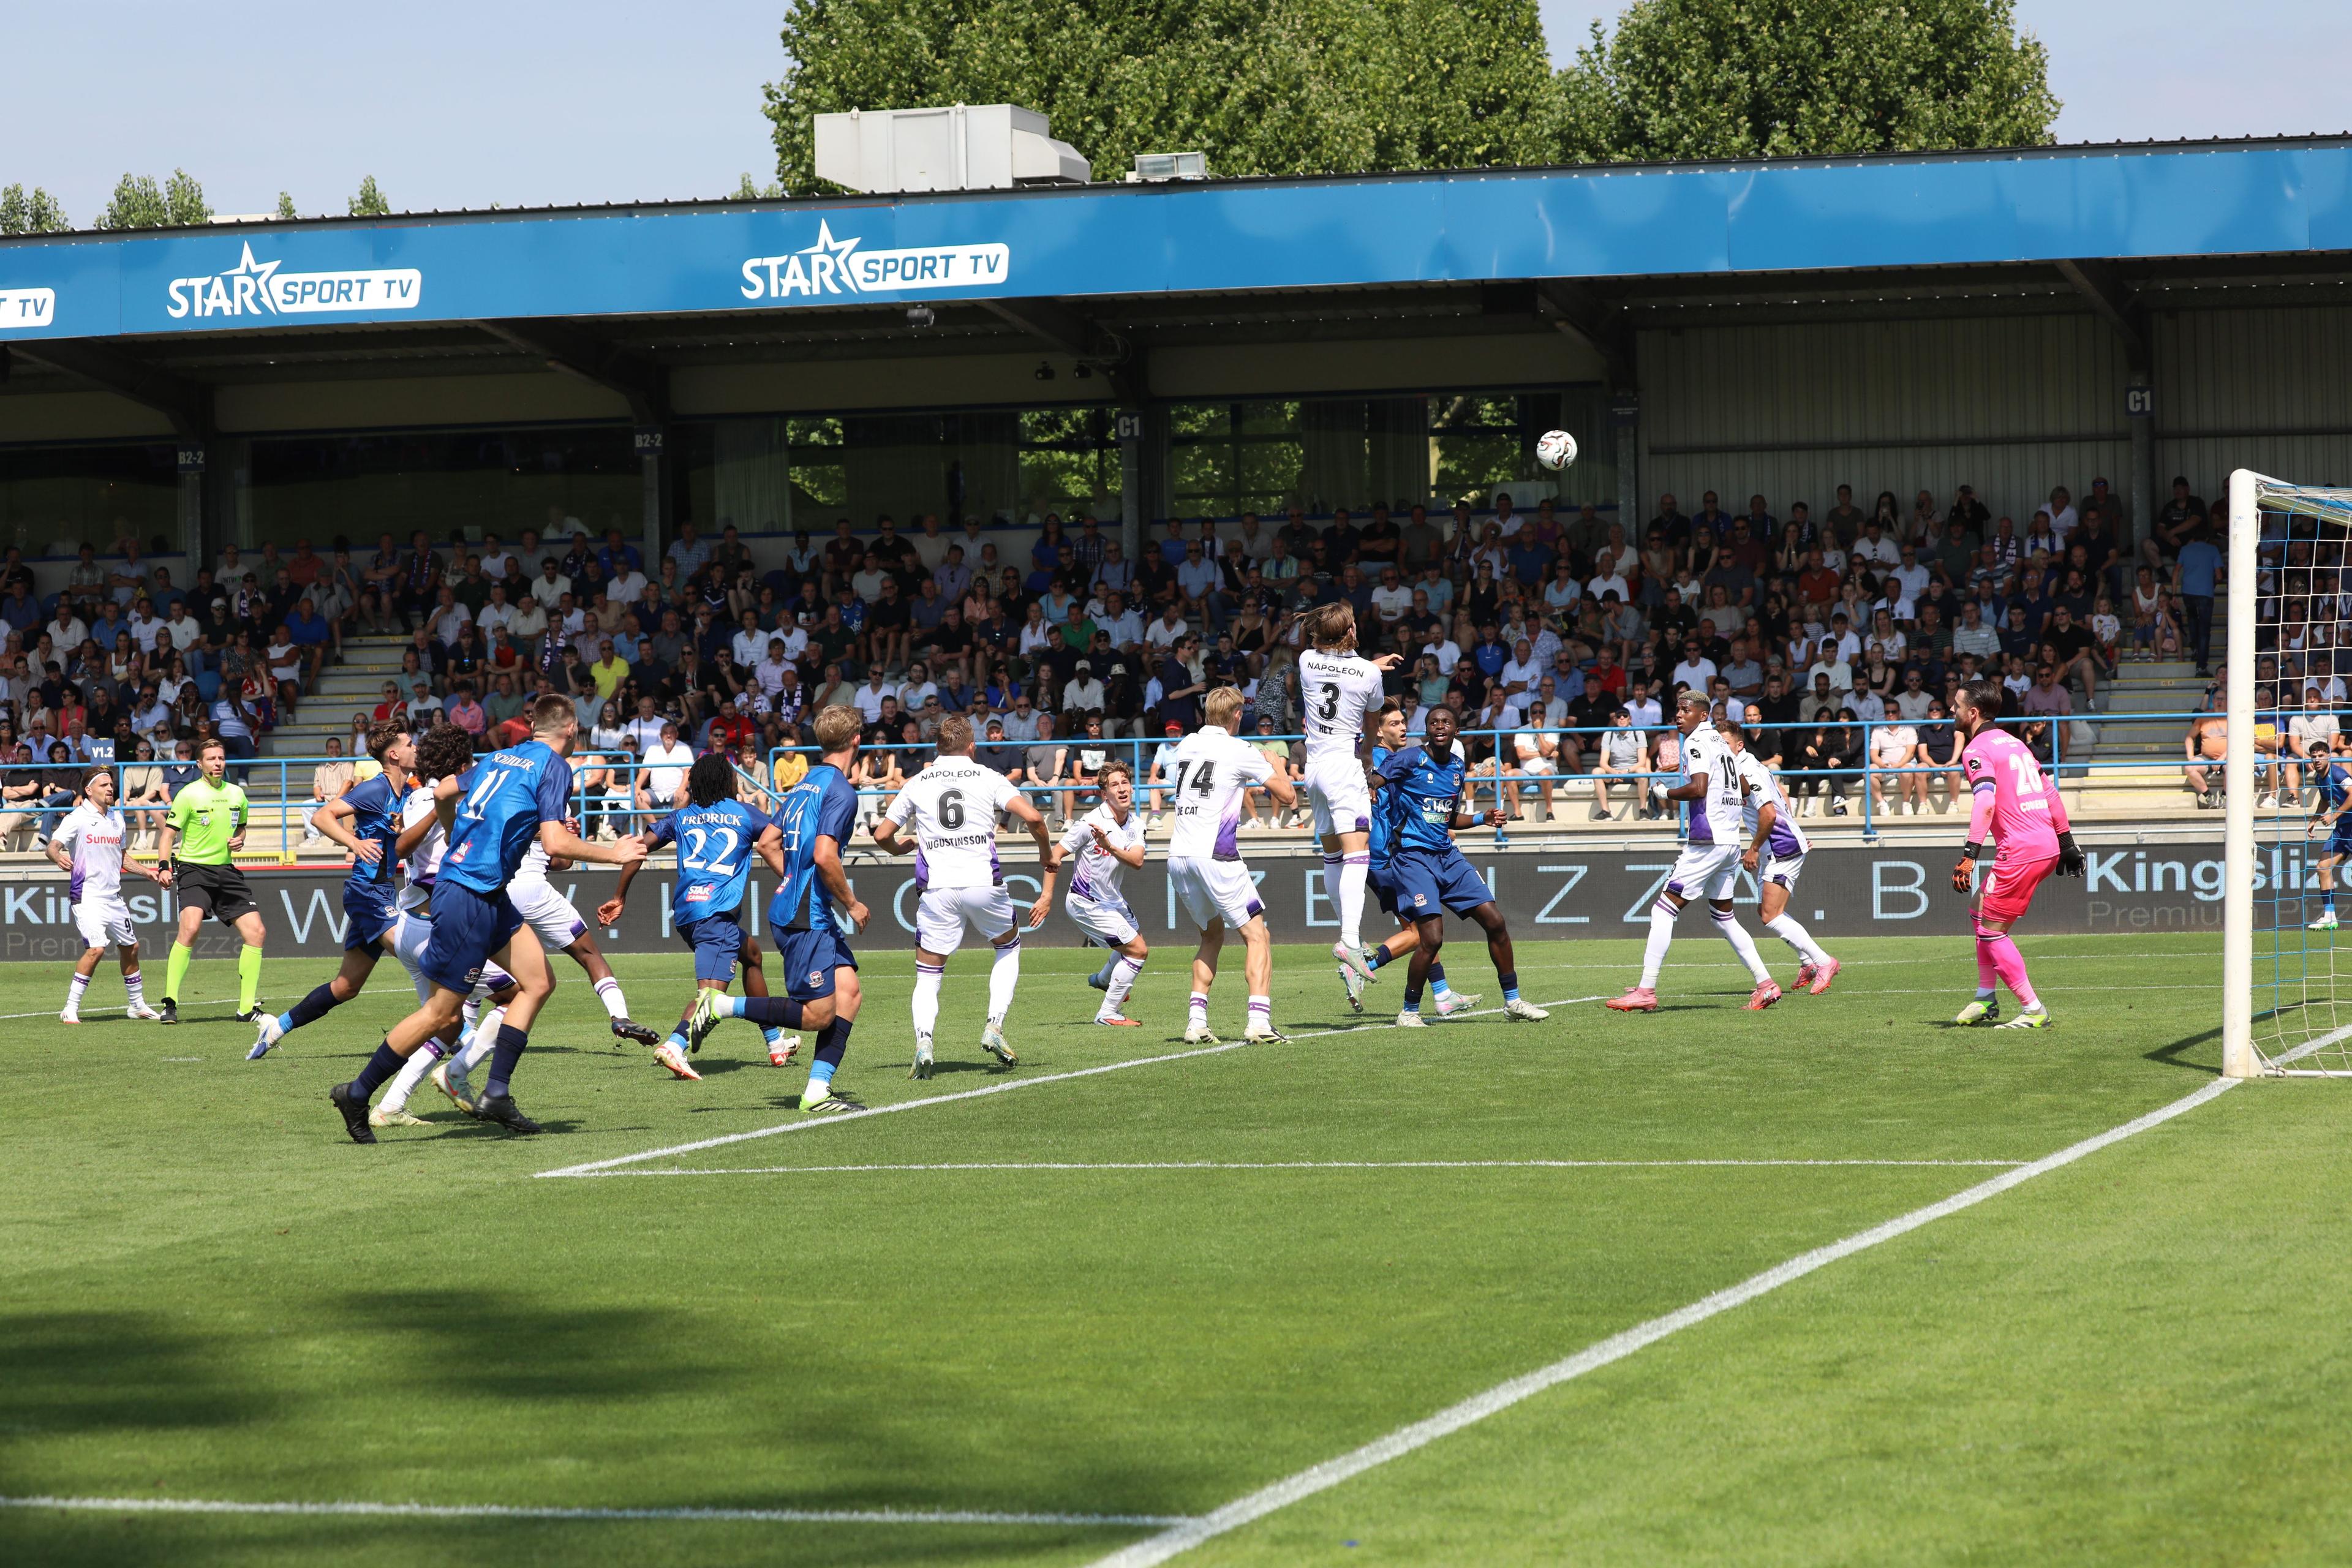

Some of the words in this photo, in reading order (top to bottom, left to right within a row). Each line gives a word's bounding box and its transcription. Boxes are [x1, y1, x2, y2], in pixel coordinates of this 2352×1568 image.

[740, 254, 842, 300] STAR
[862, 254, 956, 283] SPORT
[969, 254, 1001, 274] TV
[18, 296, 47, 318] TV
[167, 275, 262, 318] STAR
[282, 278, 372, 305] SPORT
[383, 278, 413, 299] TV
[2128, 390, 2150, 412] C1
[1118, 416, 1139, 437] C1
[635, 433, 662, 448] B2-2
[178, 451, 205, 464] B2-2
[1308, 662, 1364, 678] NAPOLEON
[1317, 682, 1341, 721] 3
[1319, 724, 1333, 734] HEY
[92, 746, 113, 760] V1.2
[921, 770, 980, 781] NAPOLEON
[1176, 760, 1216, 799] 14
[1720, 753, 1738, 791] 19
[2009, 752, 2044, 796] 26
[462, 768, 510, 821] 11
[1721, 797, 1743, 806] ANGULO
[681, 813, 742, 827] FREDRICK
[937, 788, 966, 831] 6
[1177, 806, 1183, 816] DE
[1185, 806, 1199, 815] CAT
[682, 827, 739, 876] 22
[688, 886, 710, 895] STAR
